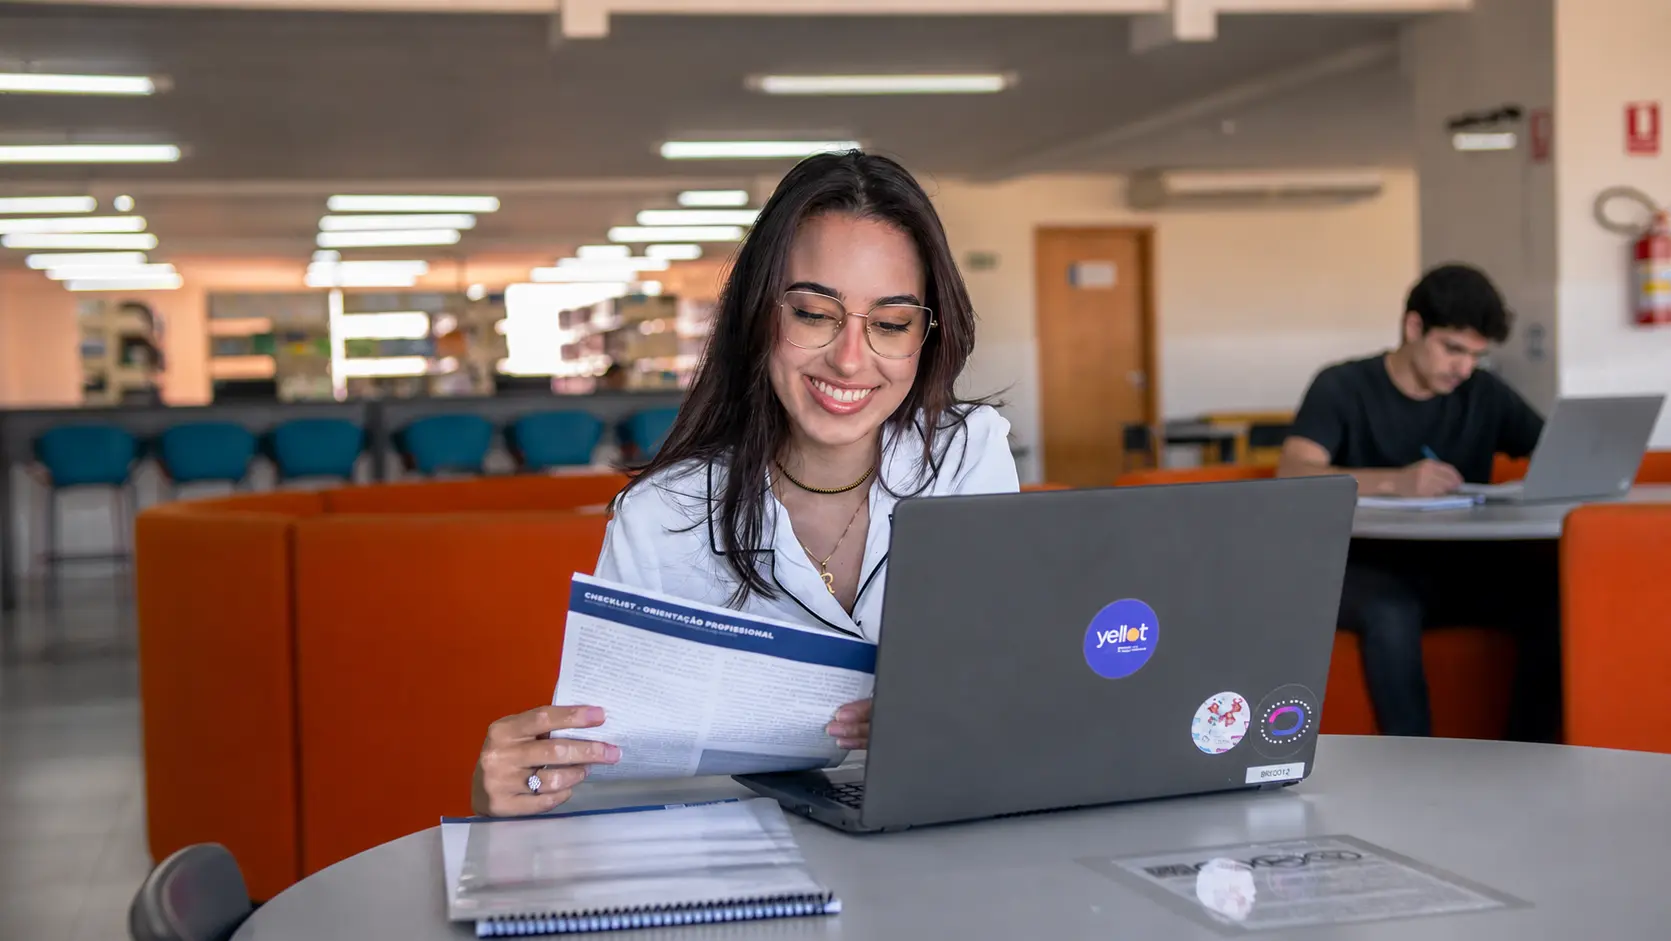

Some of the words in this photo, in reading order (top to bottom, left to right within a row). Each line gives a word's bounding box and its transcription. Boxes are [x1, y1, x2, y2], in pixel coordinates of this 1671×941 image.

[820, 572, 835, 593] R
[584, 592, 636, 610] CHECKLIST
[643, 606, 704, 626] ORIENTAÇÃO
[705, 621, 774, 640] PROFISSIONAL
[1096, 623, 1149, 649] yellot
